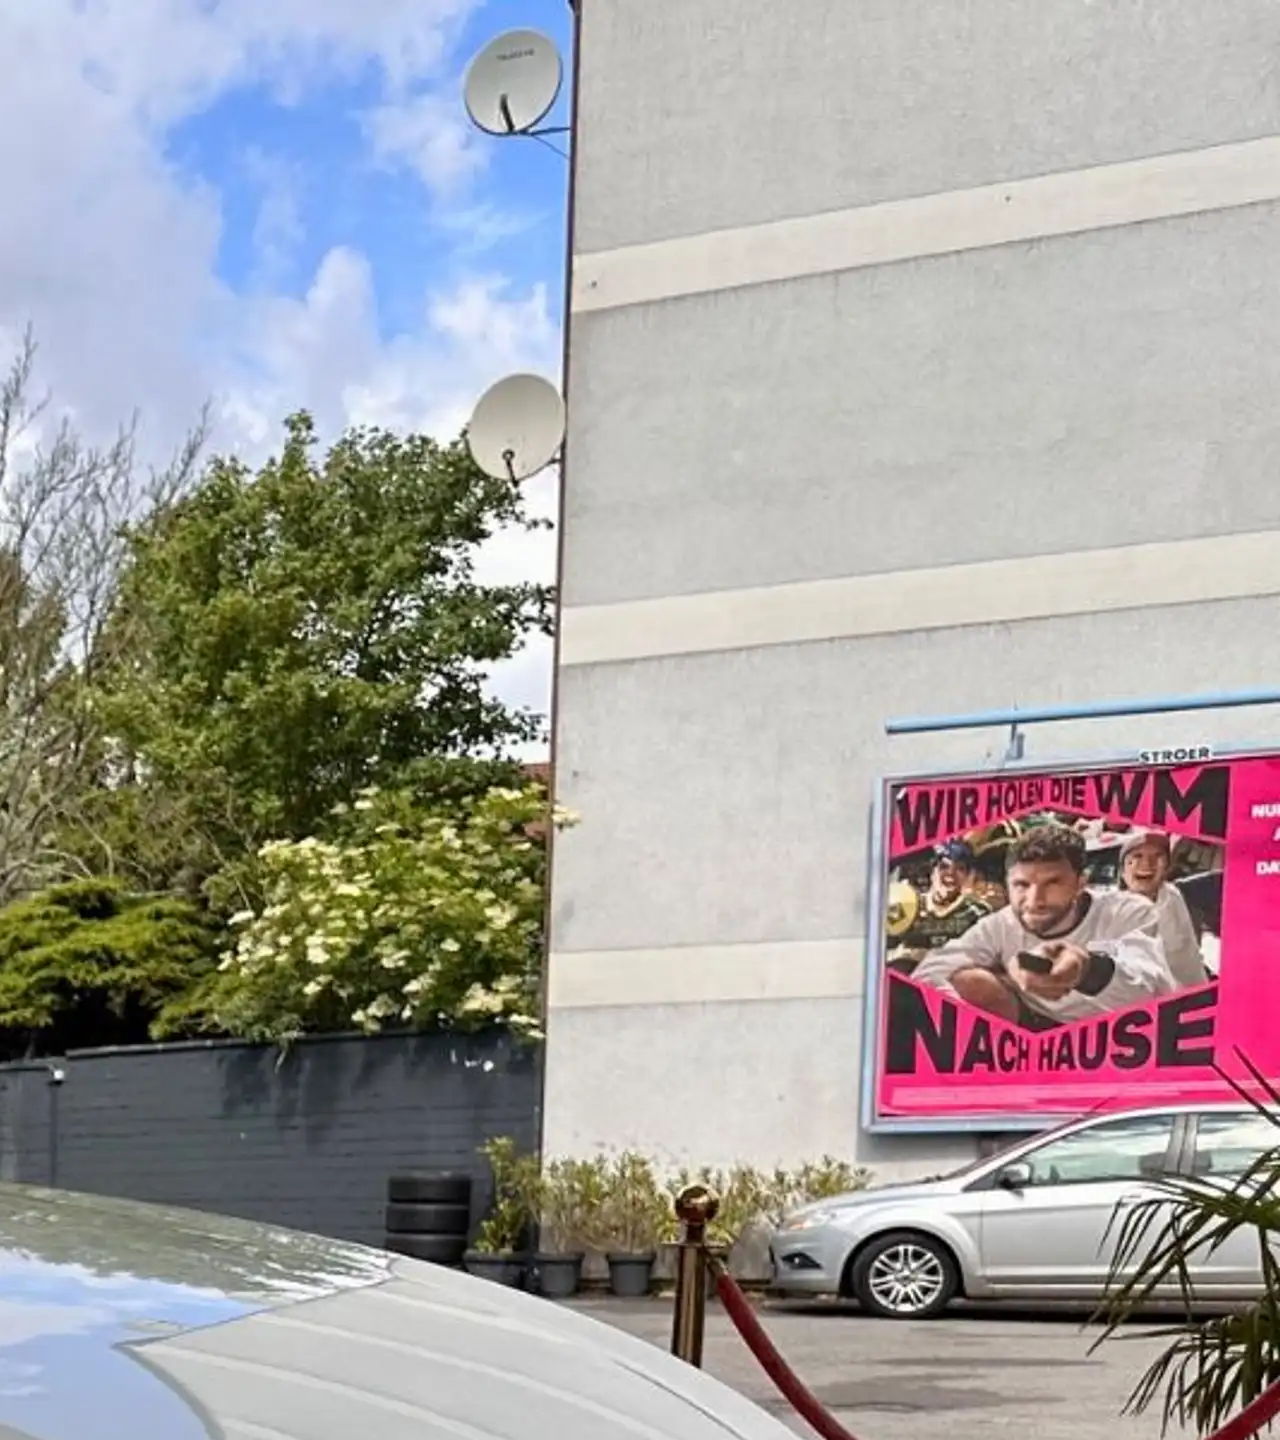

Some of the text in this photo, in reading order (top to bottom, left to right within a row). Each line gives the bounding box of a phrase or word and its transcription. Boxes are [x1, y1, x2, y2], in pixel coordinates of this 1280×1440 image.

[891, 766, 1231, 847] WIR HOLEN DIE WM
[886, 973, 1218, 1075] NACH HAUSE
